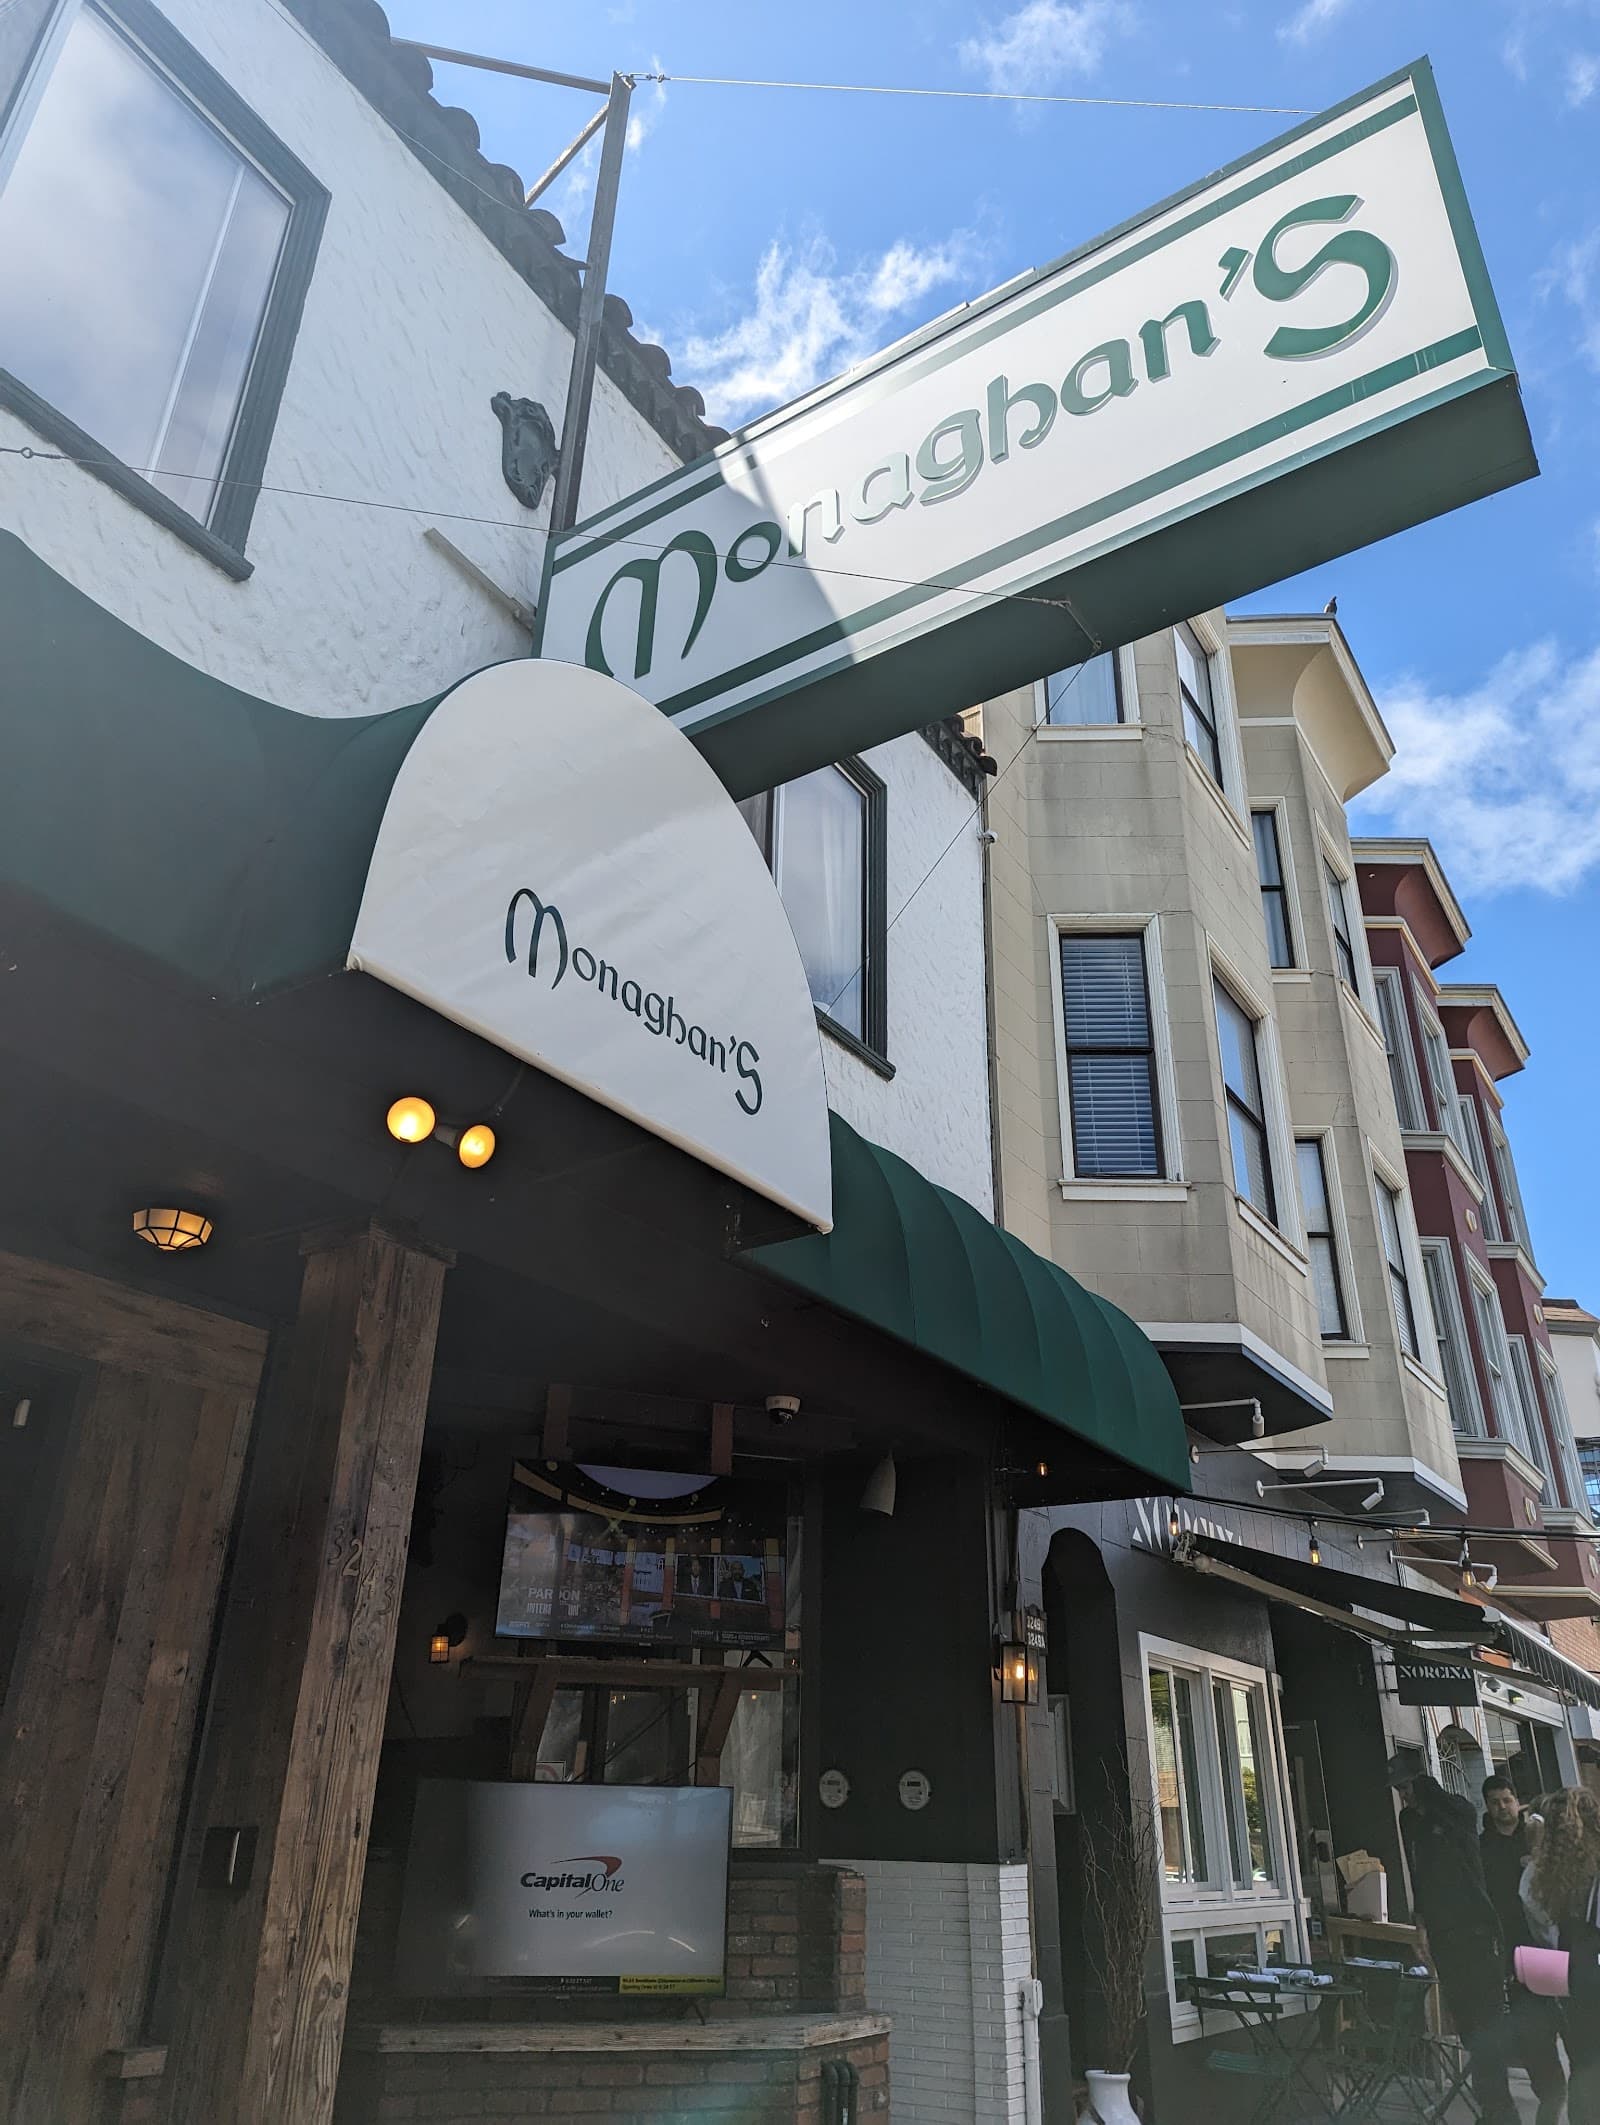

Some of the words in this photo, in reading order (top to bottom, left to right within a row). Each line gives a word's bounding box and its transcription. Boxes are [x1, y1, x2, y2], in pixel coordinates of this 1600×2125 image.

[528, 1587, 581, 1601] PARON
[1399, 1665, 1472, 1680] NORCINA
[528, 1908, 555, 1919] What's
[556, 1909, 565, 1918] in
[566, 1911, 583, 1920] your
[585, 1909, 613, 1919] wallet?
